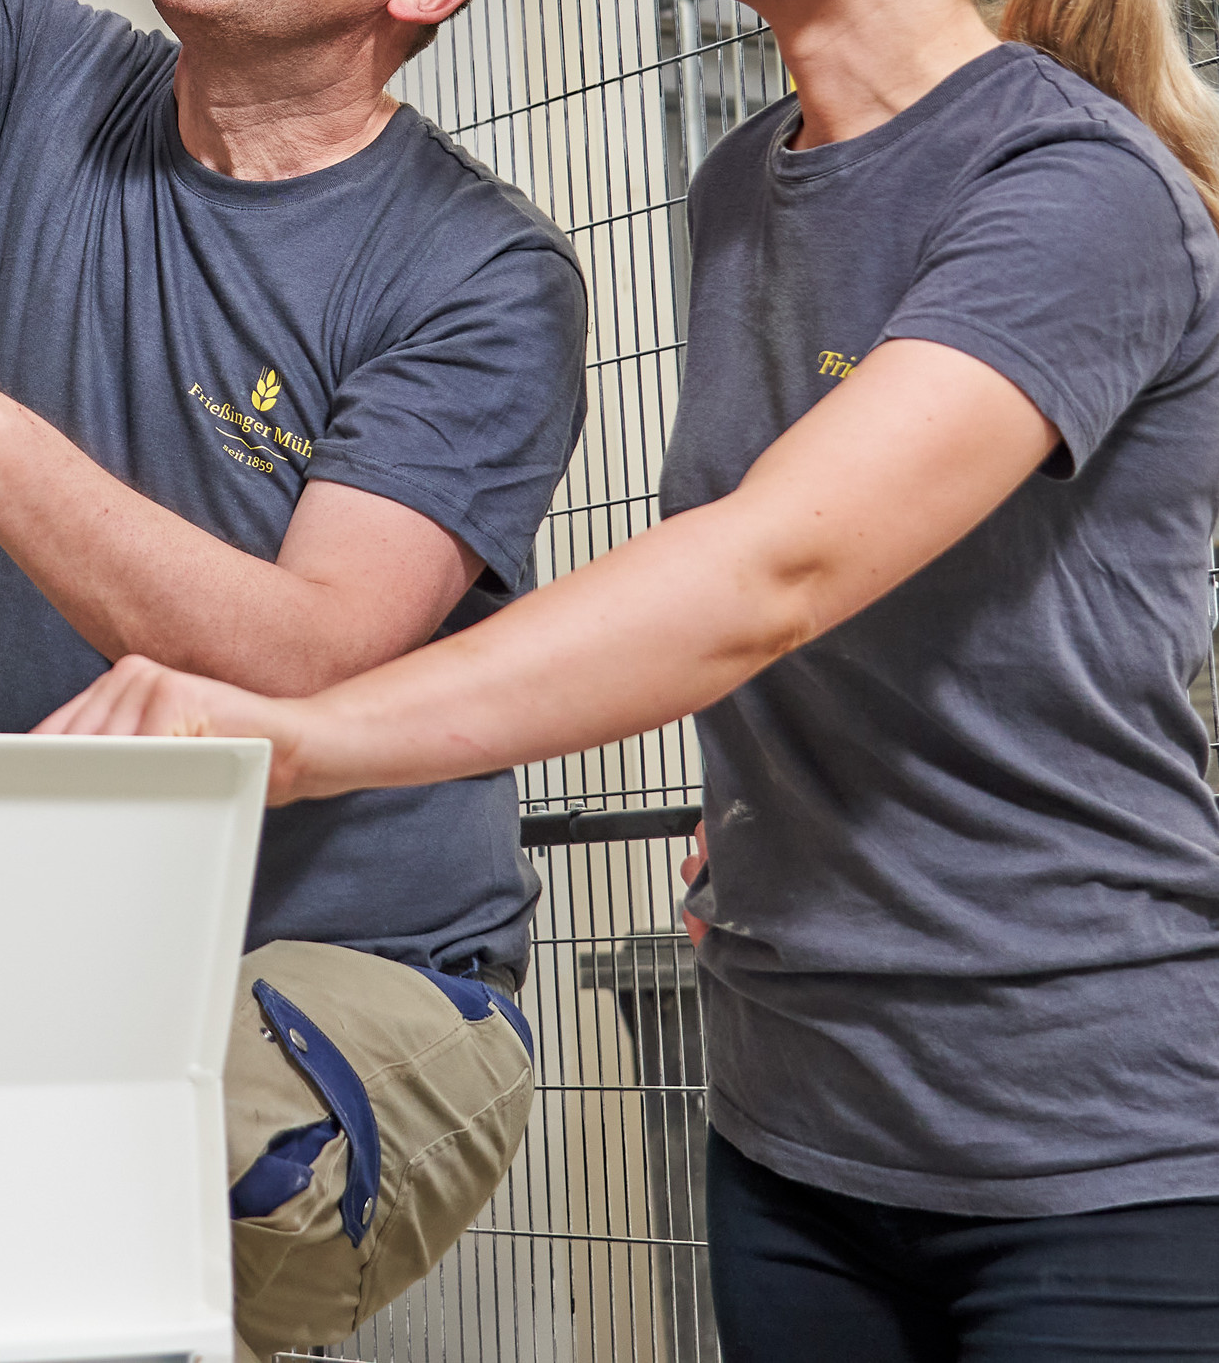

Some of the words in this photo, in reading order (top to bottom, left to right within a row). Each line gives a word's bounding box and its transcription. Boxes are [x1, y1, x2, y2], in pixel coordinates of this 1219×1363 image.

[818, 350, 858, 378] Fri
[188, 382, 272, 438] Frießinger
[223, 444, 246, 463] seit
[246, 455, 274, 474] 1859
